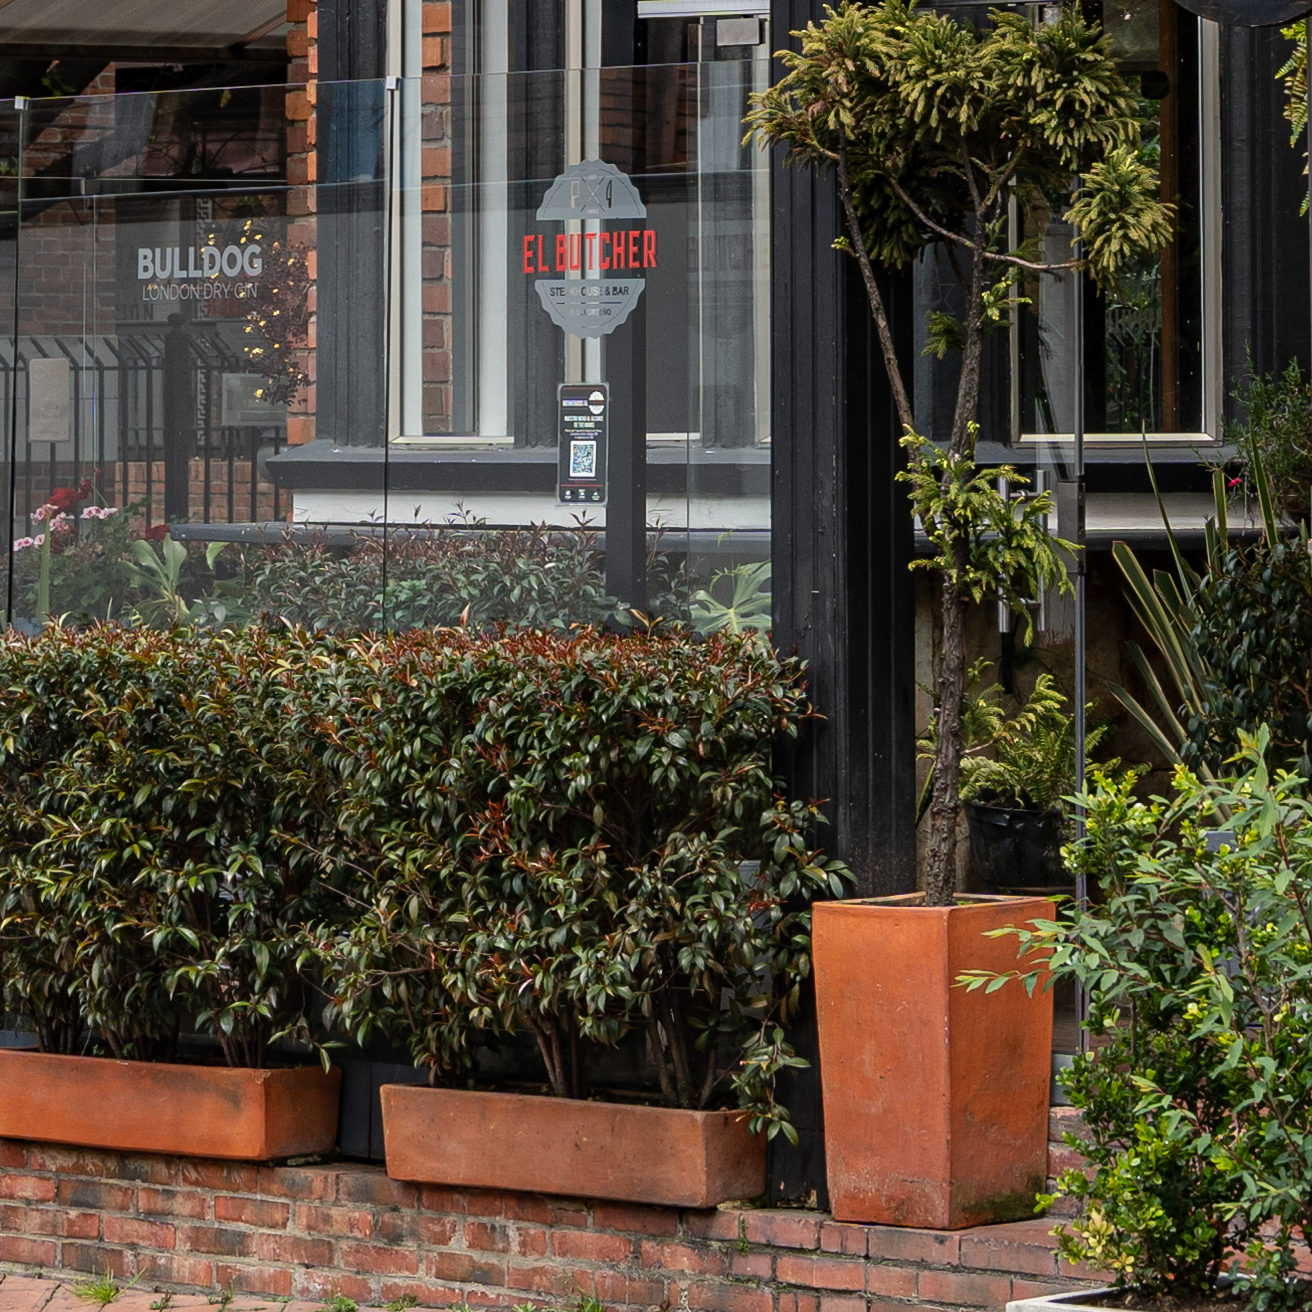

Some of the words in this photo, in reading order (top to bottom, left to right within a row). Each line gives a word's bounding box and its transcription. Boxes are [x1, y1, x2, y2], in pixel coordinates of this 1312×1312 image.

[138, 244, 263, 279] BULLDOG
[523, 234, 550, 273] EL
[555, 229, 657, 272] BUTCHER
[142, 283, 200, 301] LONDON
[203, 282, 230, 299] DRY
[234, 282, 259, 299] GIN
[605, 286, 611, 296] &
[612, 285, 630, 296] BAR
